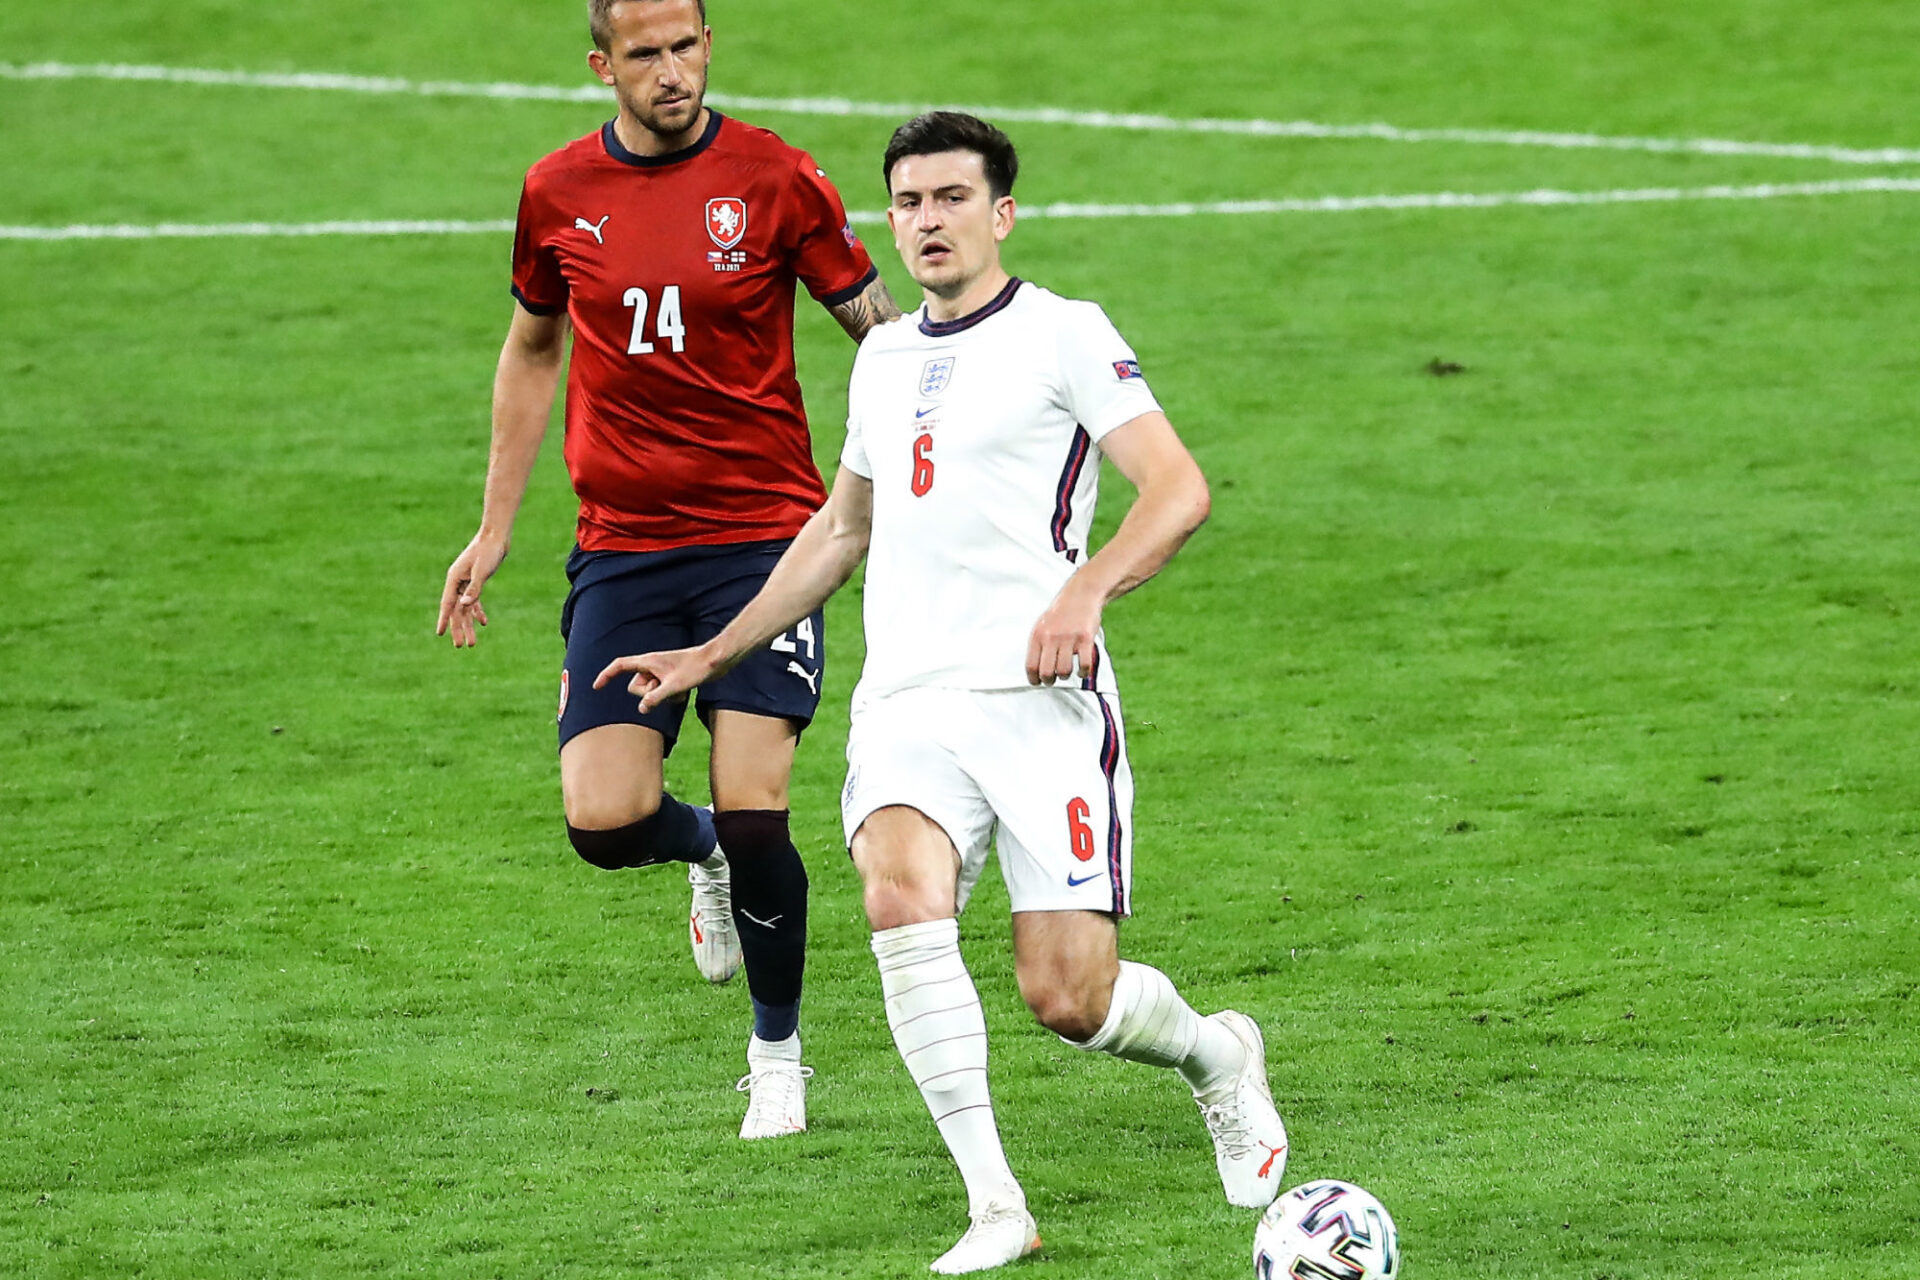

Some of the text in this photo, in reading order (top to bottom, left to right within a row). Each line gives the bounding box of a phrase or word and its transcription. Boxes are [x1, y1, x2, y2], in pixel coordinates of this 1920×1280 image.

[622, 285, 686, 355] 24
[911, 433, 935, 498] 6
[1066, 796, 1095, 862] 6
